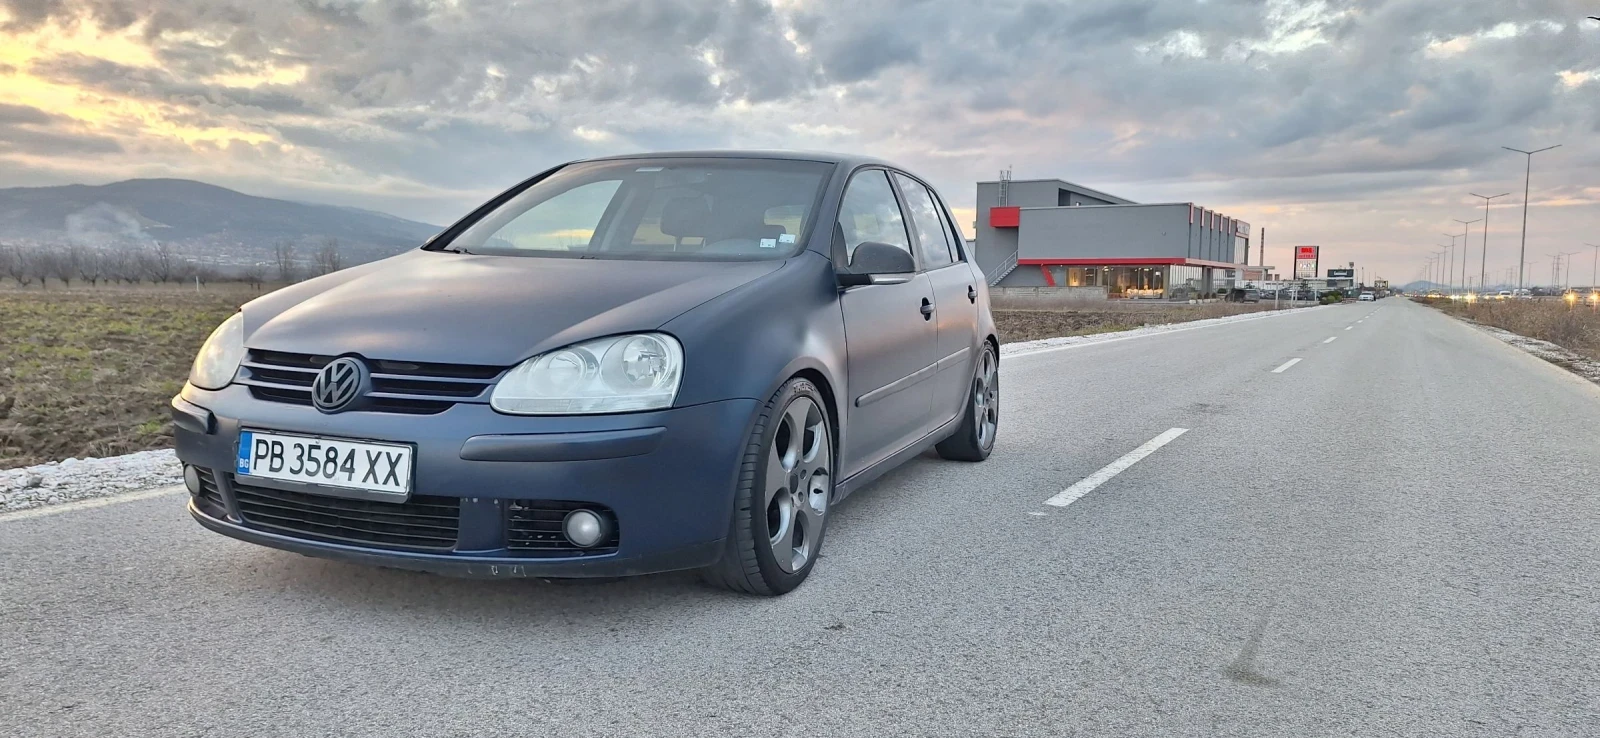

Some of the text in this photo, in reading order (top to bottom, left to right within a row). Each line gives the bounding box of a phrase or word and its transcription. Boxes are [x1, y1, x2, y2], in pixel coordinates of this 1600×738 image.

[314, 359, 358, 406] VW
[239, 458, 249, 468] BG
[253, 439, 403, 486] PB 3584 XX
